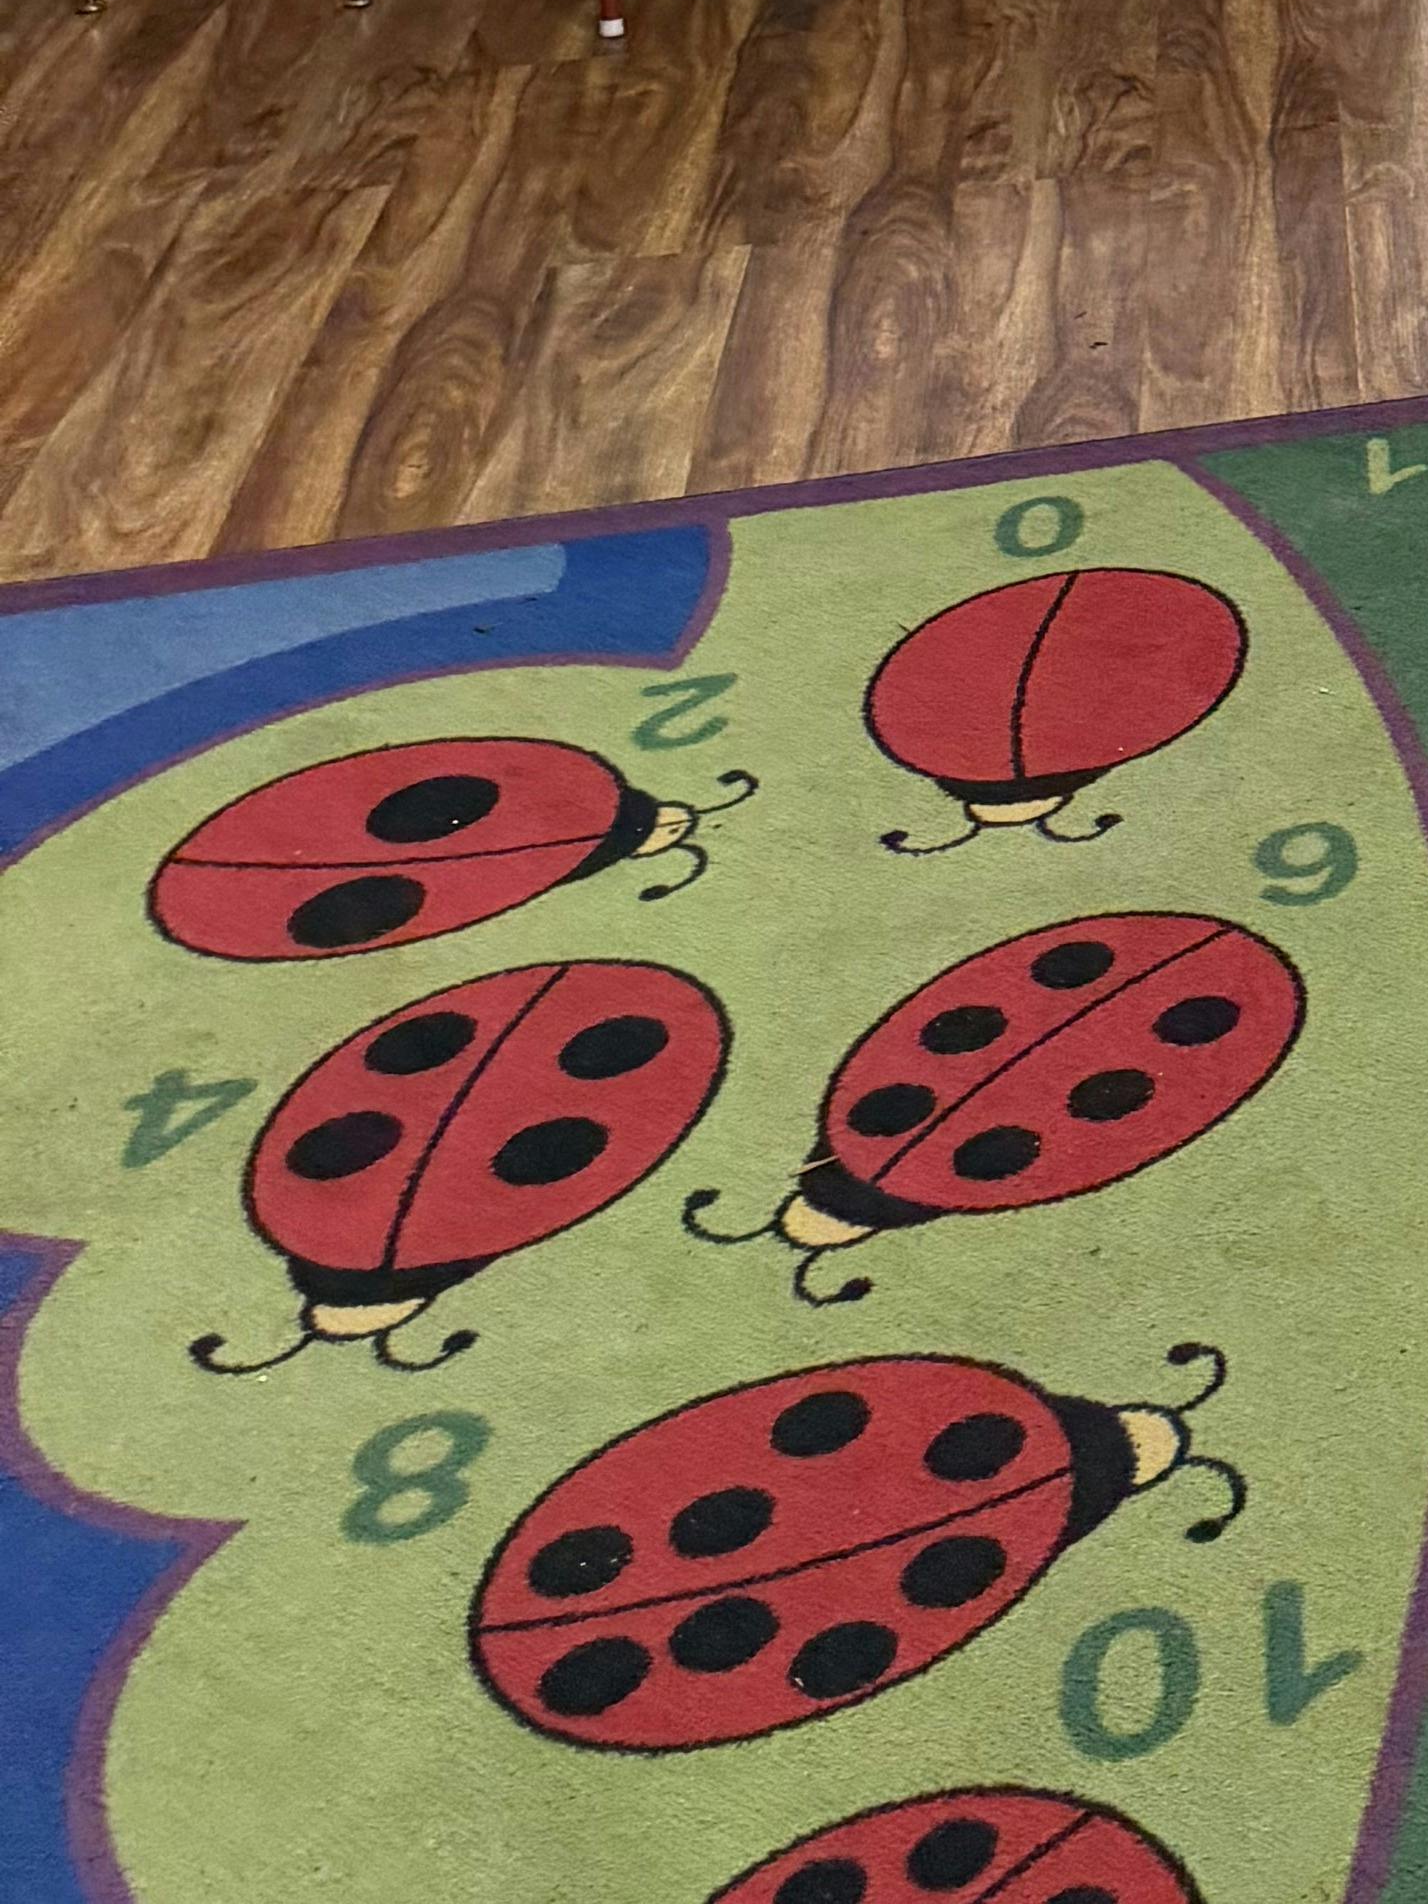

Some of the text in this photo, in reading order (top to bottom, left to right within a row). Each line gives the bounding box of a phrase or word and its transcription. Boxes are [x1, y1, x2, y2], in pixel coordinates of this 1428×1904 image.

[1364, 438, 1426, 495] 1
[997, 495, 1085, 558] 0
[633, 672, 739, 751] 2
[123, 1068, 259, 1169] 4
[339, 1409, 491, 1545] 8
[1059, 1582, 1362, 1763] 10
